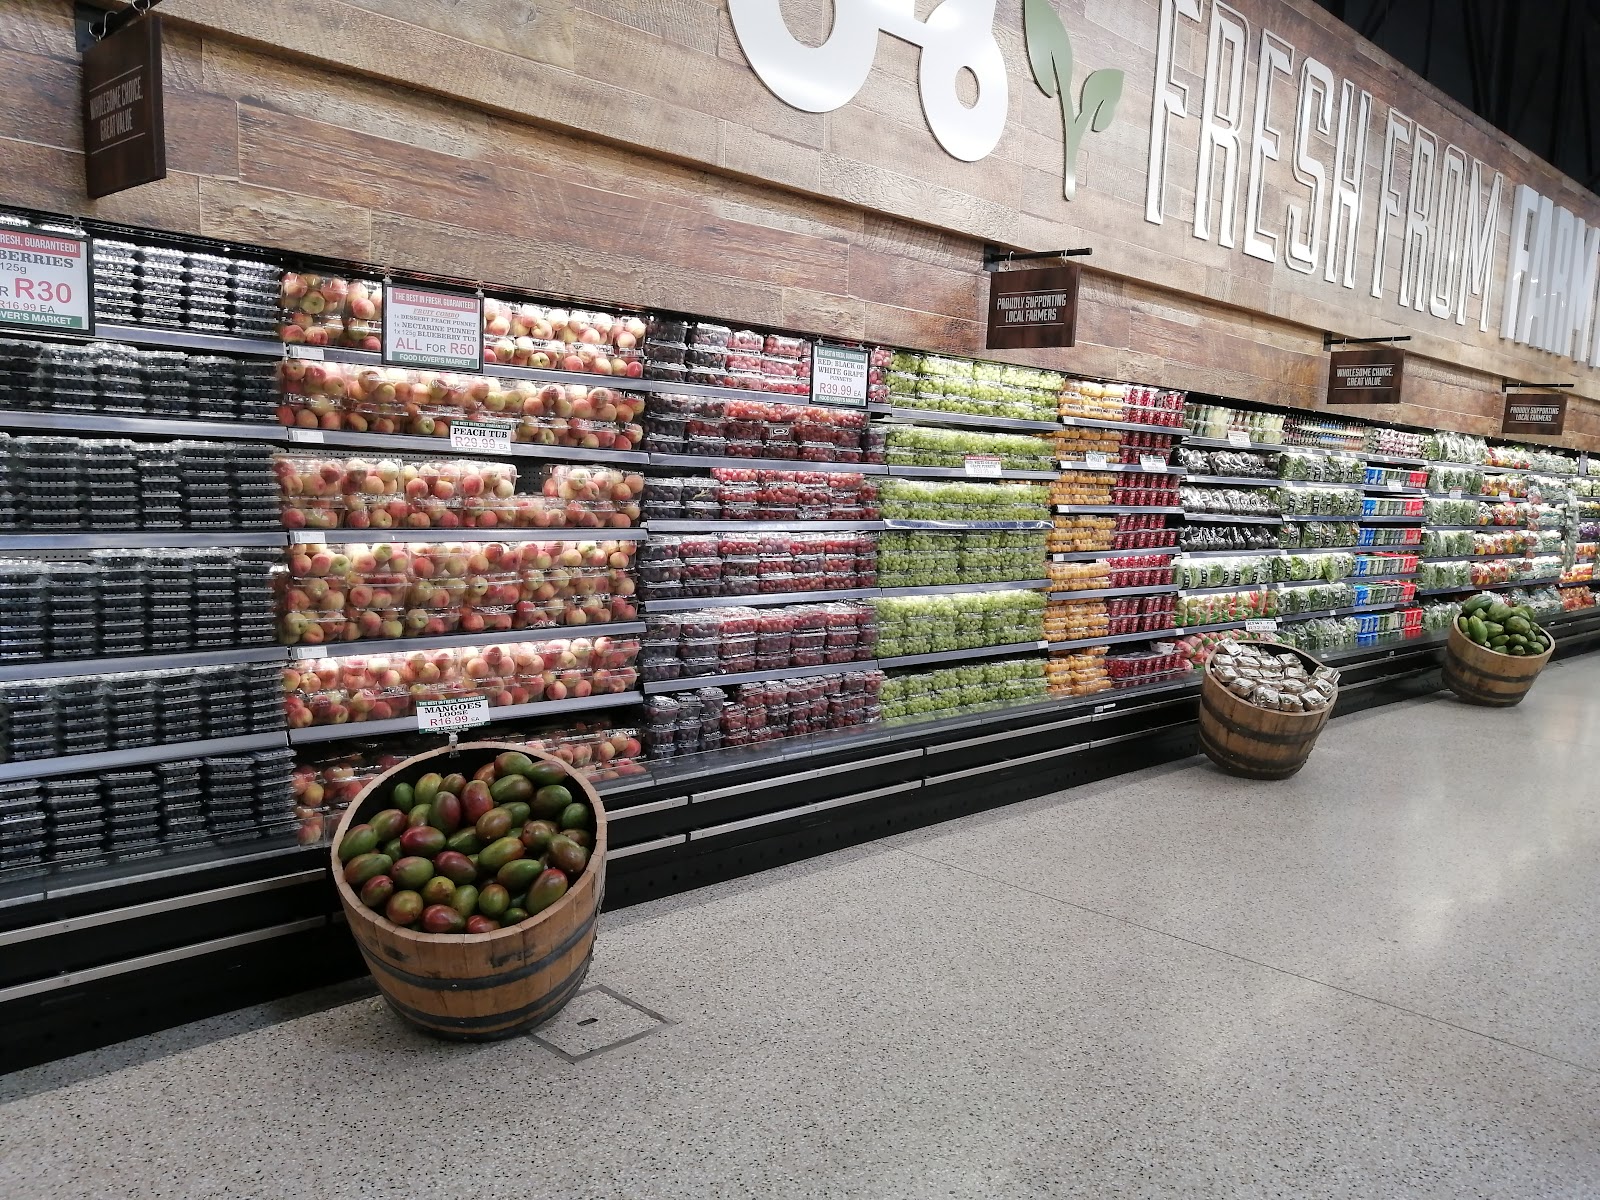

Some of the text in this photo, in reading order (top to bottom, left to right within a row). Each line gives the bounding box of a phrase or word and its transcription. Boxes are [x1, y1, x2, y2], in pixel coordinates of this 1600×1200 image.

[101, 107, 133, 141] GREAT VALUE
[1145, 0, 1372, 289] FRESH
[1370, 106, 1503, 332] FROM
[1500, 184, 1600, 368] FARM
[25, 237, 77, 254] GUARANTEED!
[15, 277, 72, 304] R30
[395, 292, 405, 301] THE
[406, 293, 418, 302] BEST
[419, 294, 425, 302] IN
[443, 297, 476, 309] GUARANTEED!
[996, 294, 1067, 310] PROUDLY SUPPORTING
[40, 304, 55, 313] EA
[435, 310, 460, 319] COMBO
[0, 310, 72, 325] VER'S MARKET
[400, 314, 429, 322] DESSERT
[430, 317, 451, 325] PEACH
[1005, 308, 1057, 323] LOCAL FARMERS
[401, 322, 445, 332] NECTARINE
[446, 327, 476, 335] PUNNET
[402, 329, 416, 337] 125g
[417, 331, 461, 341] BLUEBERRY
[395, 337, 475, 356] ALL FOR R50
[418, 355, 444, 363] LOVER'S
[445, 358, 471, 366] MARKET
[834, 360, 856, 369] BLACK
[818, 366, 865, 378] WHITE GRAPE
[1336, 368, 1372, 377] WHOLESOME
[1346, 376, 1382, 386] GREAT VALUE
[820, 382, 852, 396] R39.99
[1509, 406, 1560, 415] PROUDLY SUPPORTING
[453, 427, 508, 439] PEACH TUB
[455, 436, 496, 449] R29.99
[424, 702, 482, 714] MANGOES
[439, 709, 469, 718] LOOSE
[430, 715, 469, 727] R16.99
